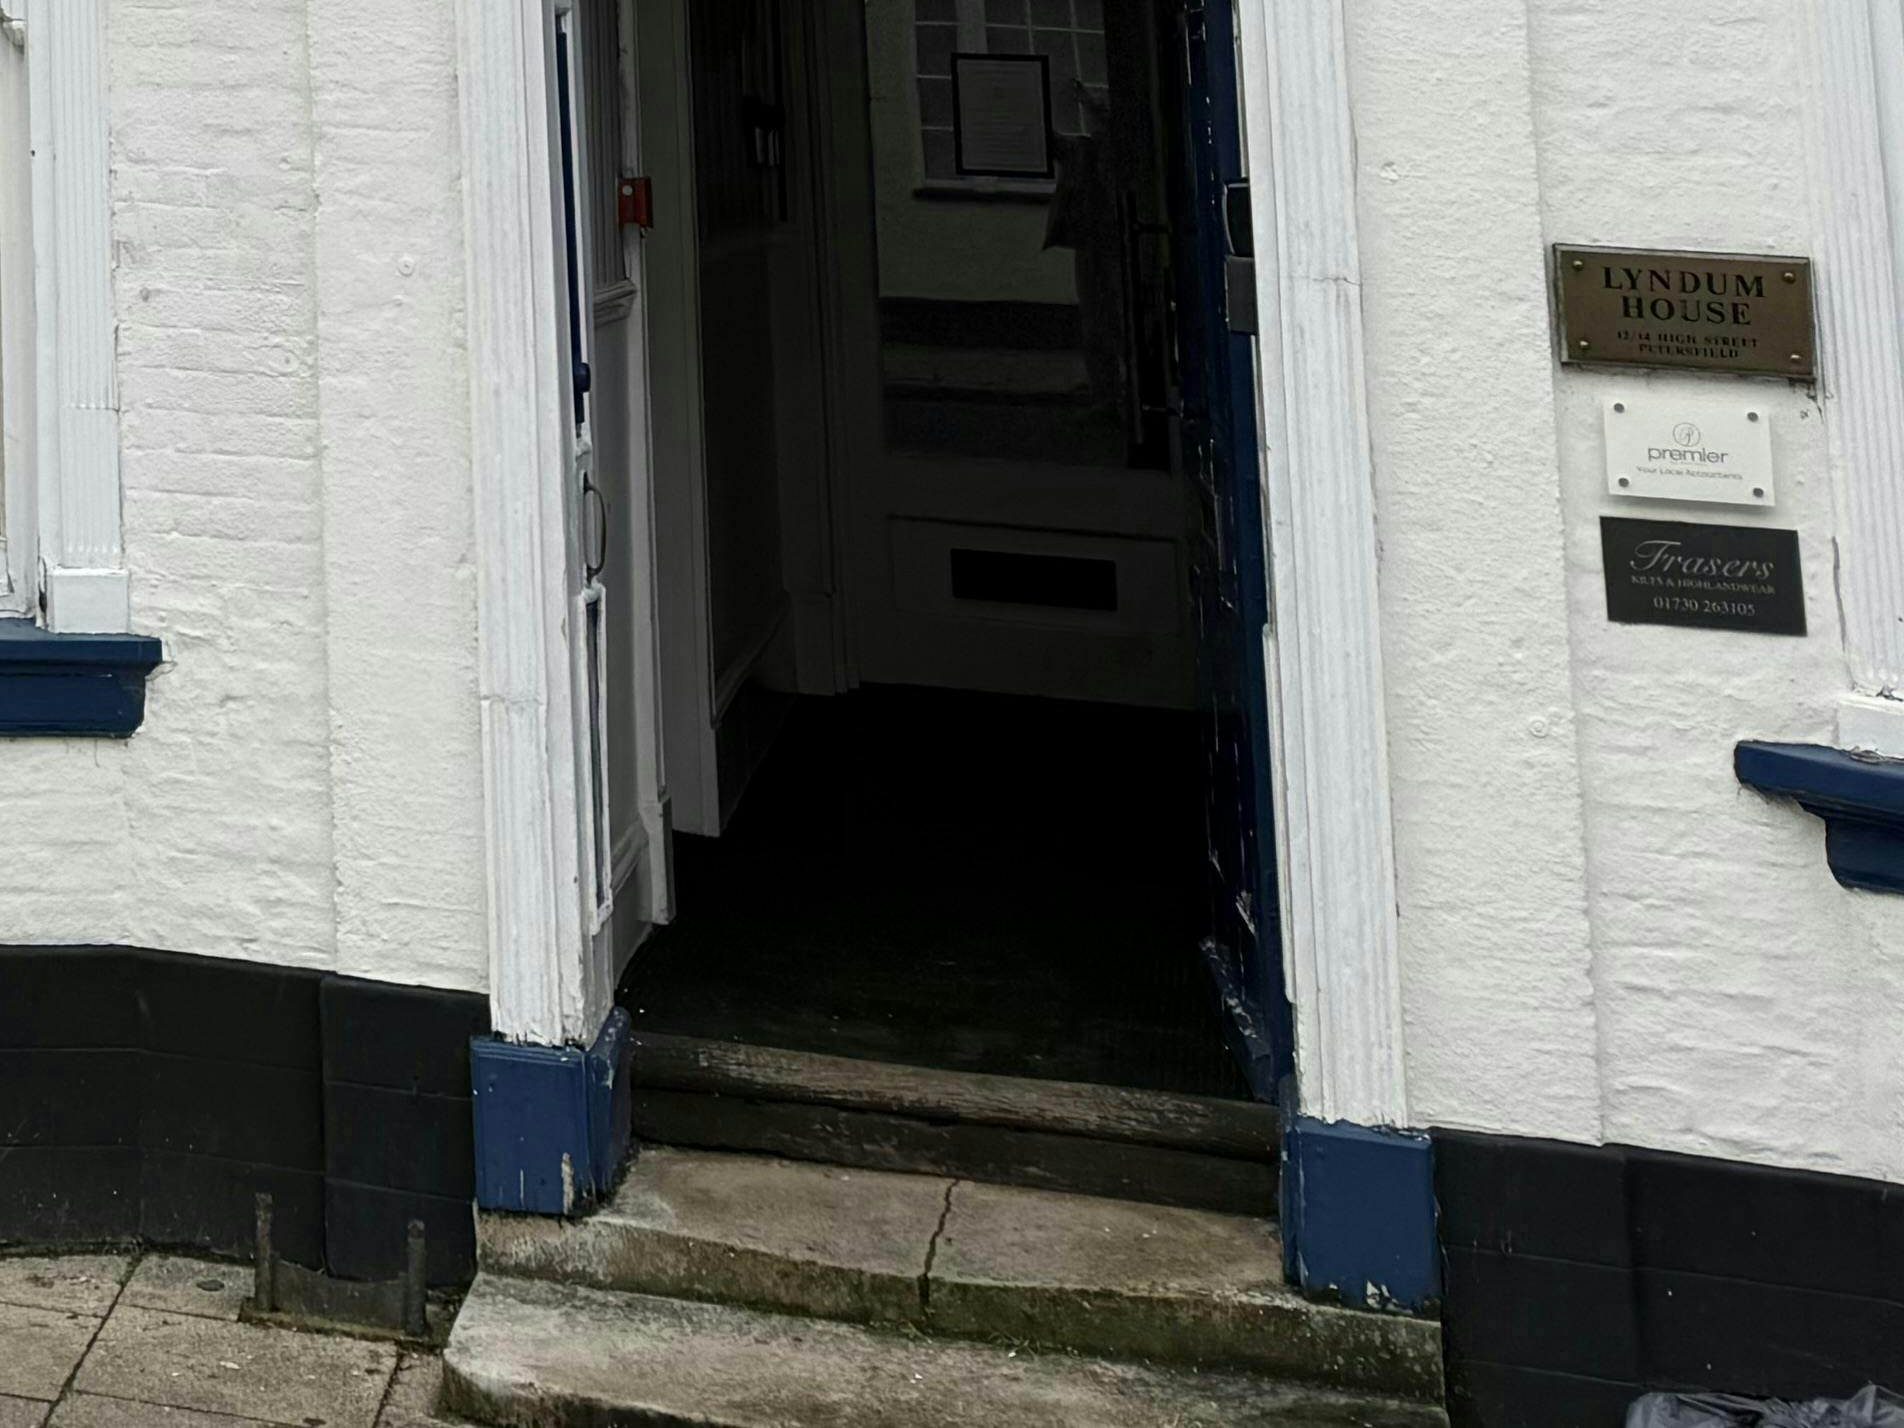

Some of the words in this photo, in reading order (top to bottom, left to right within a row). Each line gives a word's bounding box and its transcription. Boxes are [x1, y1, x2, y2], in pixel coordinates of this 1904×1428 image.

[1602, 266, 1766, 298] LYNDUM
[1622, 295, 1752, 326] HOUSE
[1658, 333, 1697, 345] HIGH
[1703, 335, 1758, 348] STREET
[1647, 447, 1729, 464] premier
[1629, 539, 1775, 581] Frasers
[1653, 596, 1699, 612] 01730
[1703, 600, 1756, 617] 263105
